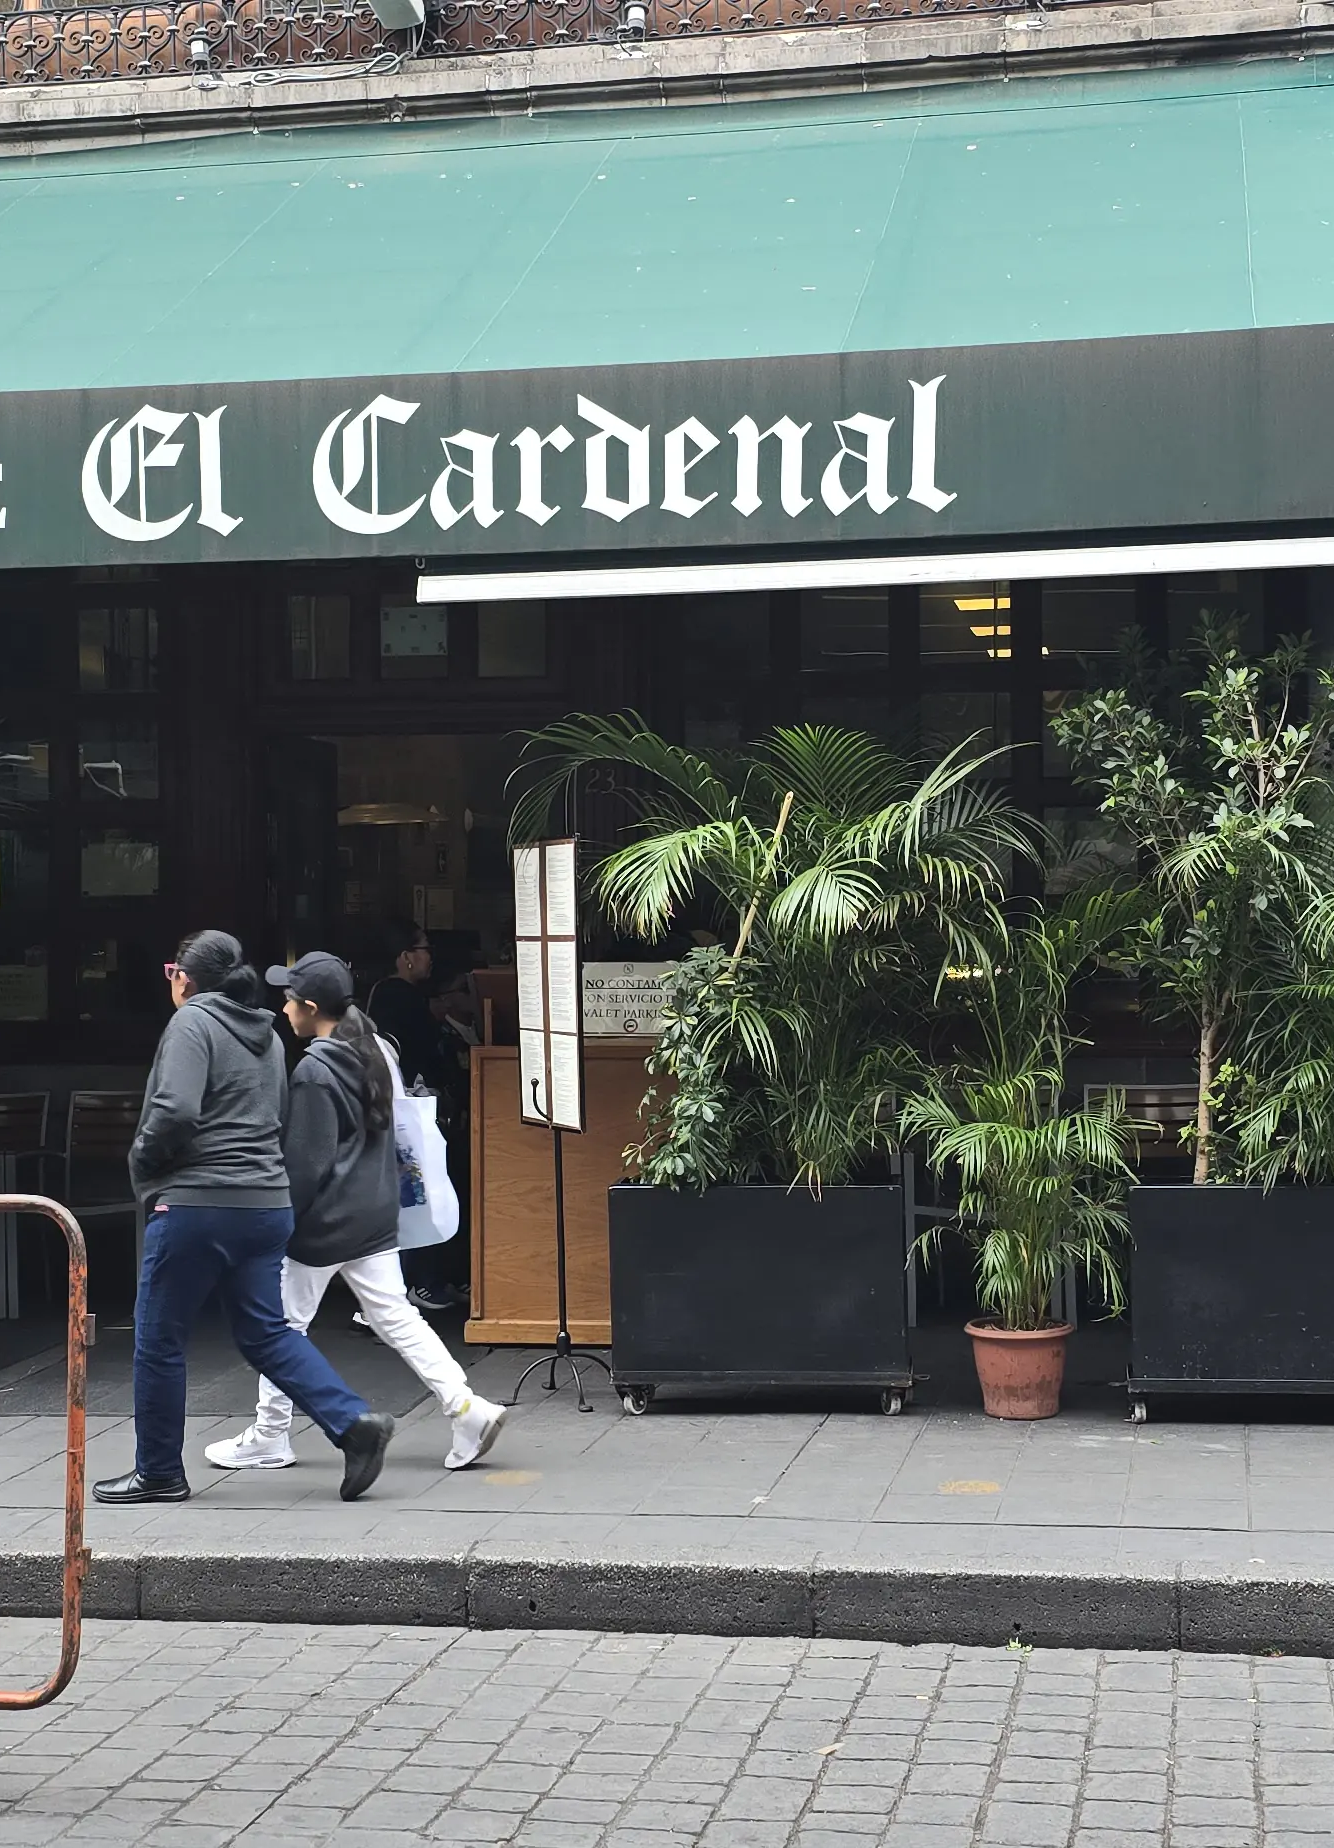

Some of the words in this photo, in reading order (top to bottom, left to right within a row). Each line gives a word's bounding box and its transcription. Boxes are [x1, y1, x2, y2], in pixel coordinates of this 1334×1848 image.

[81, 403, 244, 542] El
[312, 373, 958, 535] Cardenal
[586, 979, 605, 988] NO
[584, 994, 606, 1003] ON
[609, 994, 663, 1004] SERVICIO
[584, 1009, 621, 1018] VALET
[623, 1009, 661, 1019] PARKI
